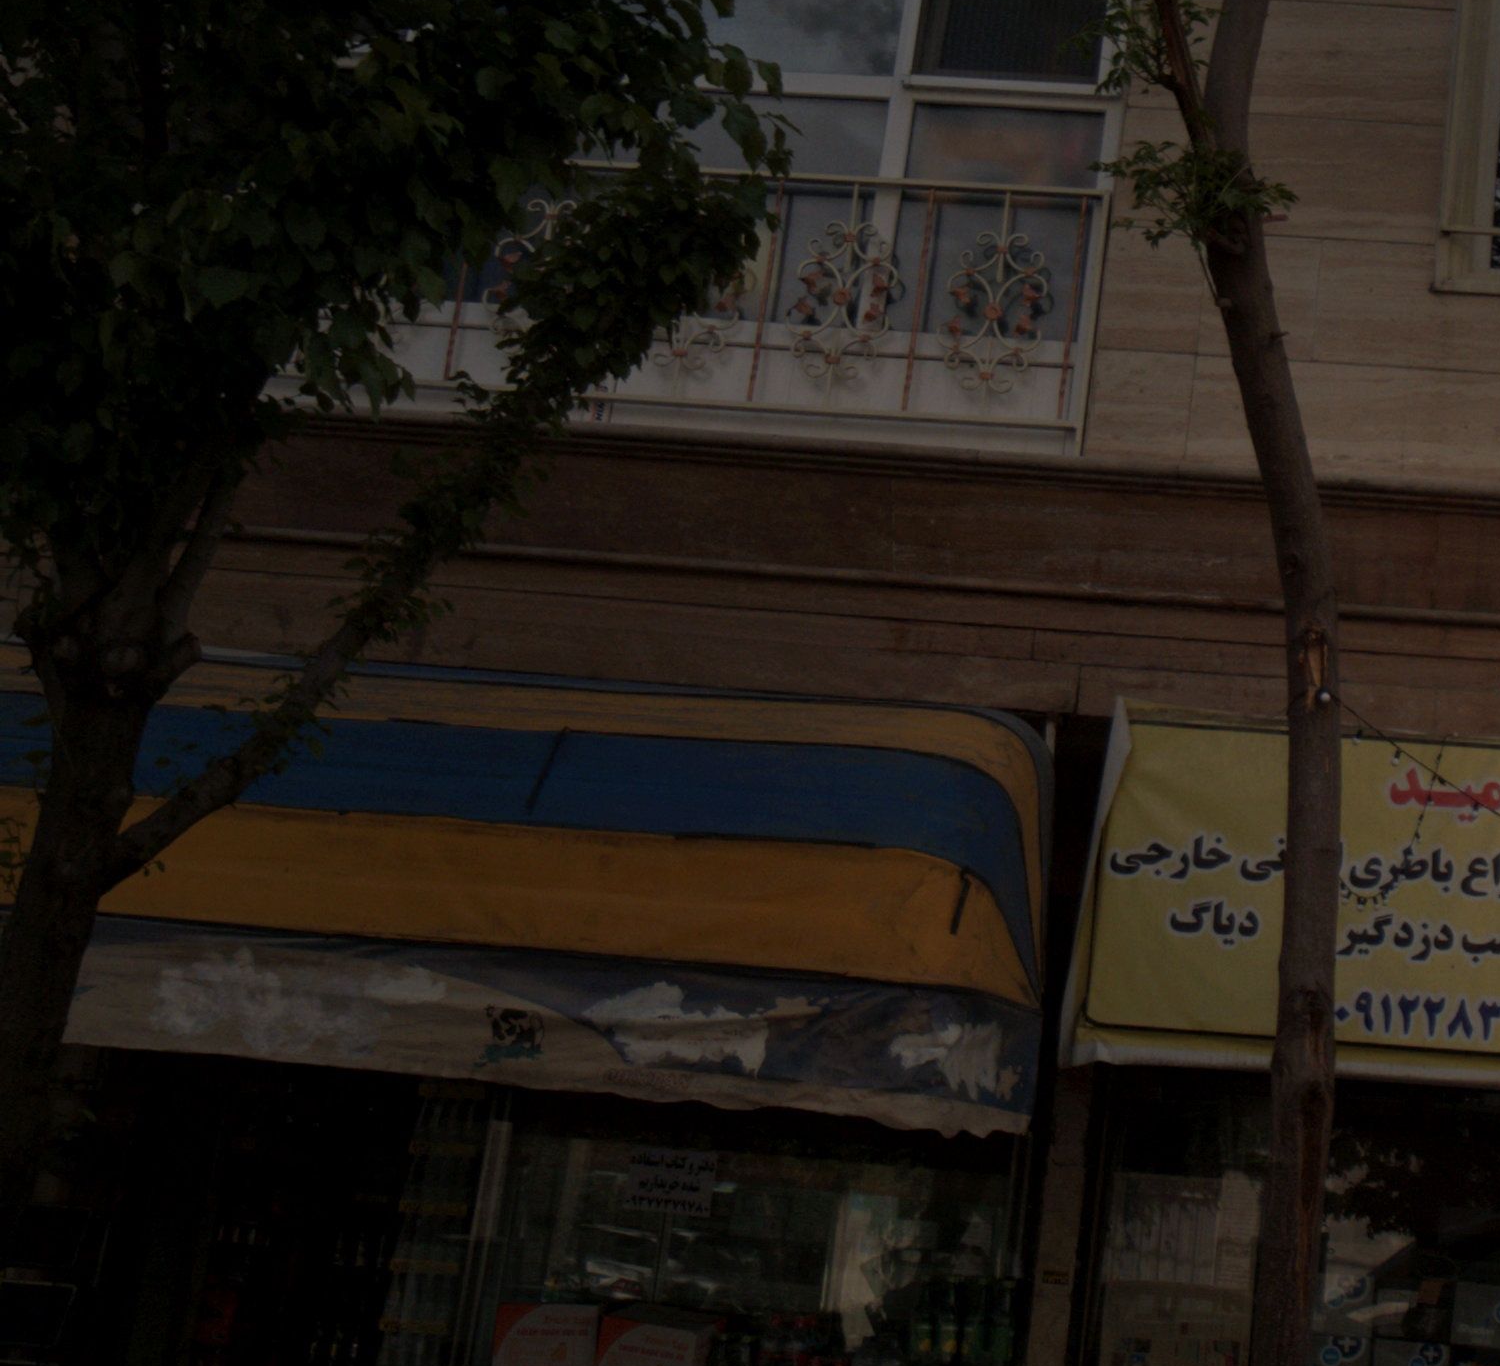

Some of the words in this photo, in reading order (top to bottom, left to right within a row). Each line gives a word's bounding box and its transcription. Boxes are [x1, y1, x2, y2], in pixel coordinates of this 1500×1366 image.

[1110, 835, 1232, 879] خارجی
[1349, 845, 1454, 894] باطری
[1170, 901, 1259, 946] دیاگ
